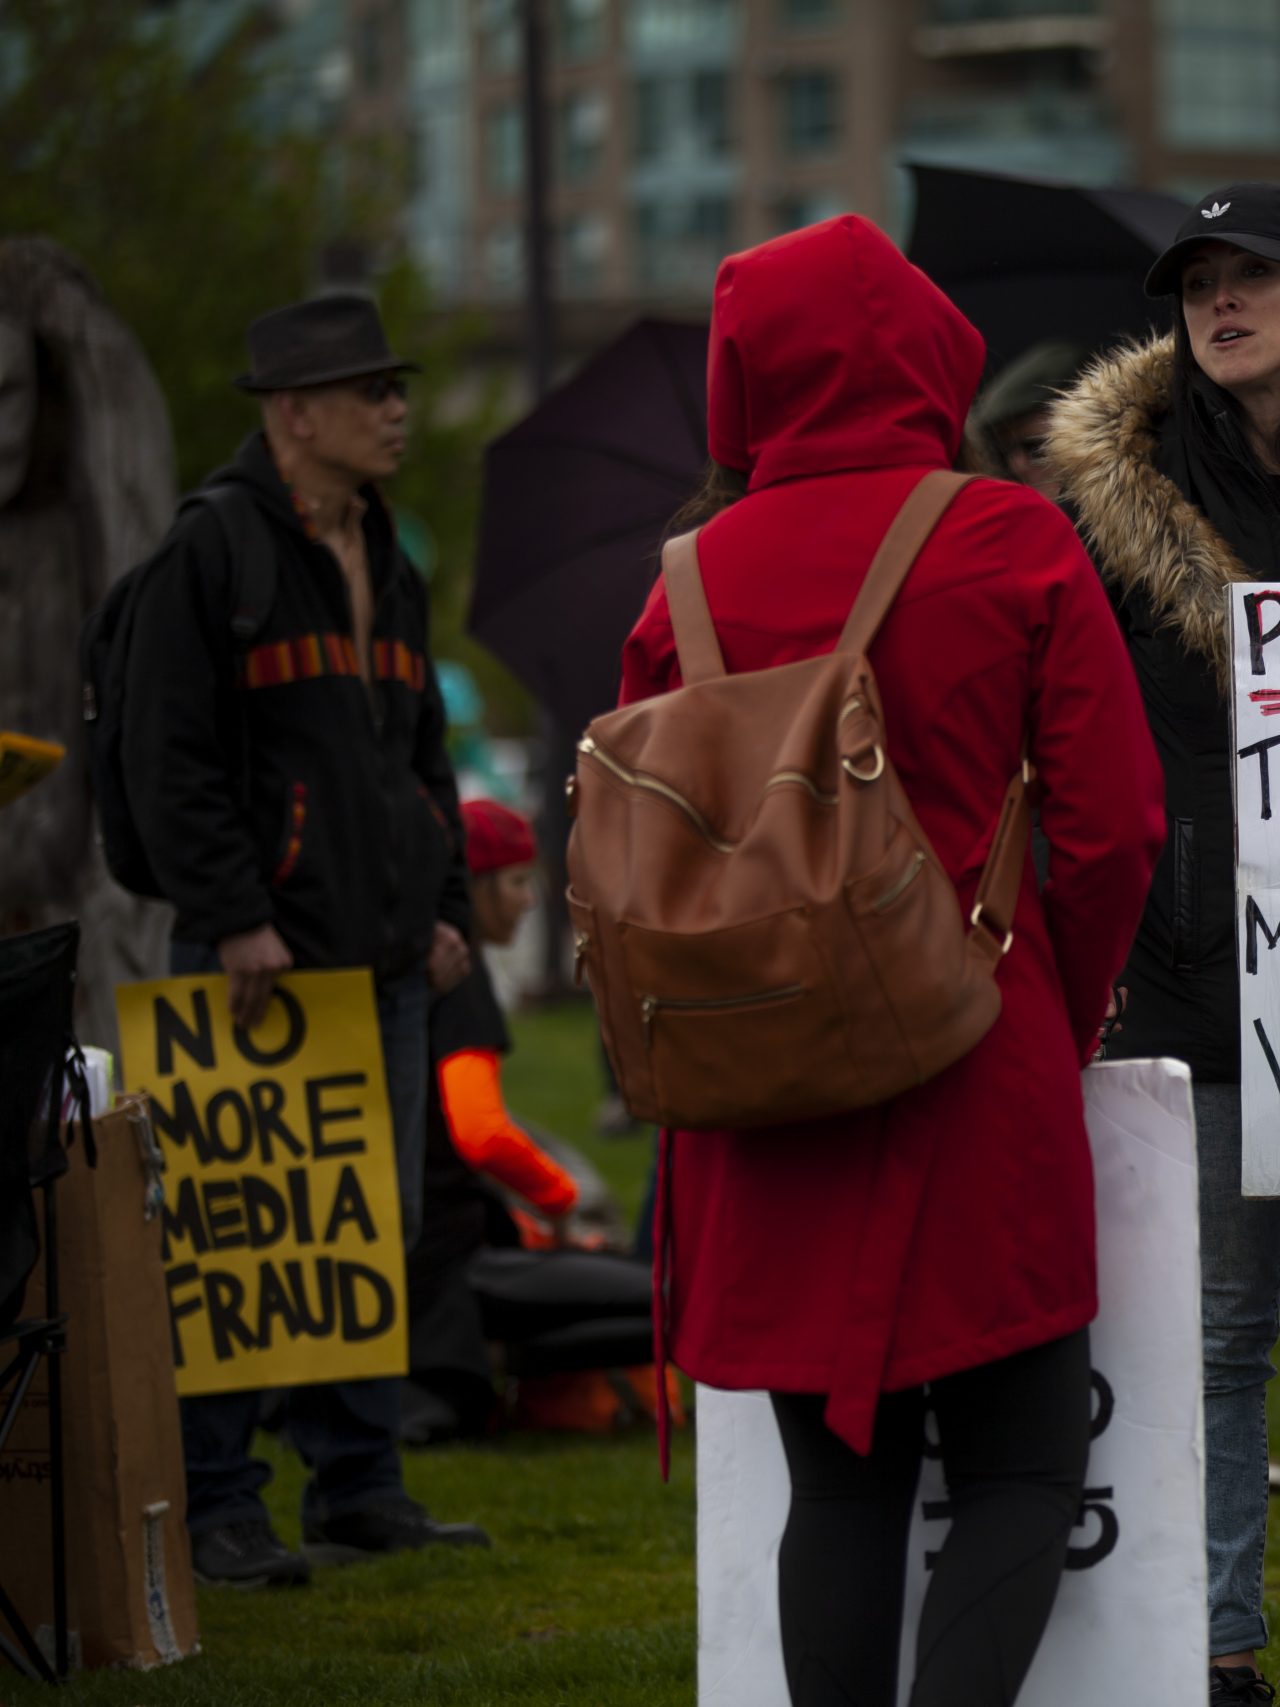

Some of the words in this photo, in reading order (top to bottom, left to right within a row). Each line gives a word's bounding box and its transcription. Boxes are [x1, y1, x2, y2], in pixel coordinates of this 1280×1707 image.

[153, 986, 307, 1077] NO
[149, 1071, 368, 1173] MORE
[160, 1163, 379, 1262] MEDIA
[164, 1255, 397, 1369] FRAUD
